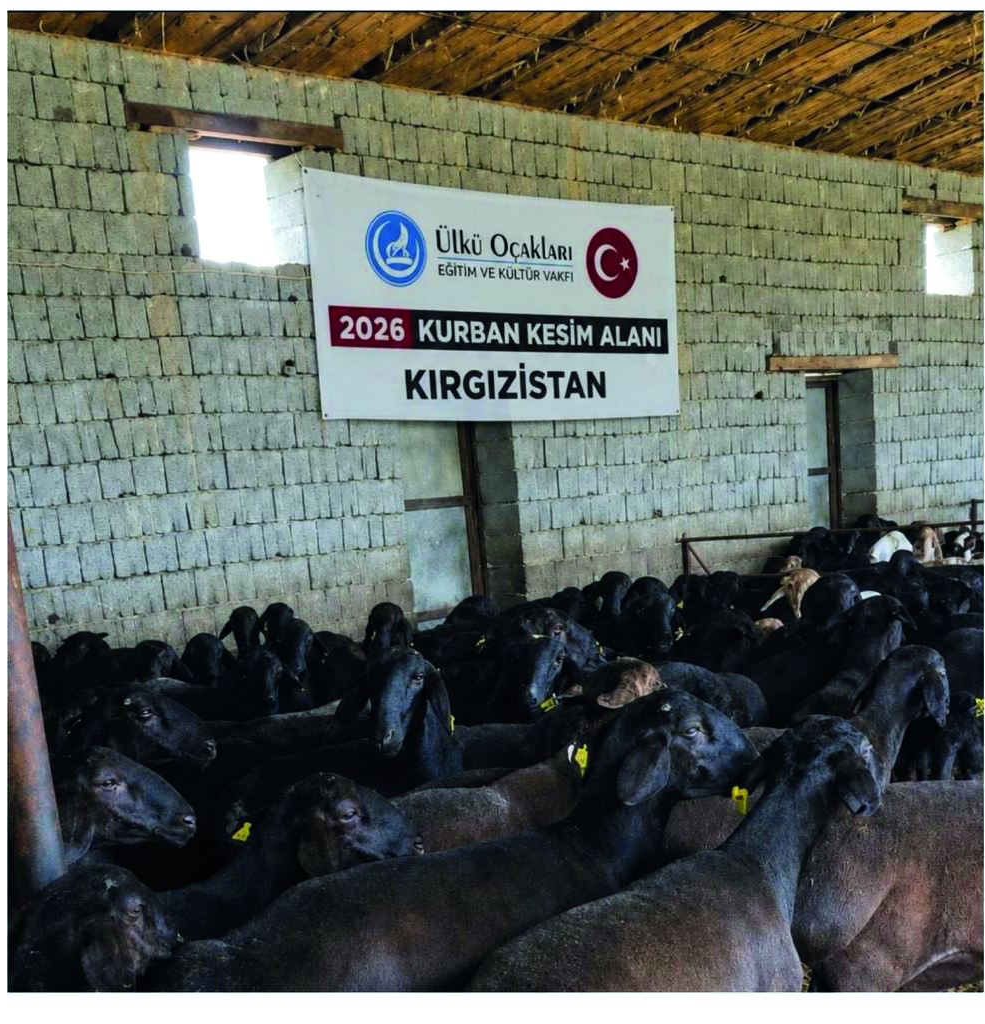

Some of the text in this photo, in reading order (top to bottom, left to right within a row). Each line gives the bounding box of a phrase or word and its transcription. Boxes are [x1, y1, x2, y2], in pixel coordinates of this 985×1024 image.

[435, 225, 482, 256] Ülkü
[438, 261, 574, 283] EĞİTİM VE KÜLTÜR VAKFI
[338, 315, 662, 347] 2026 KURBAN KESİM ALANI
[404, 362, 608, 401] KIRGIZİSTAN
